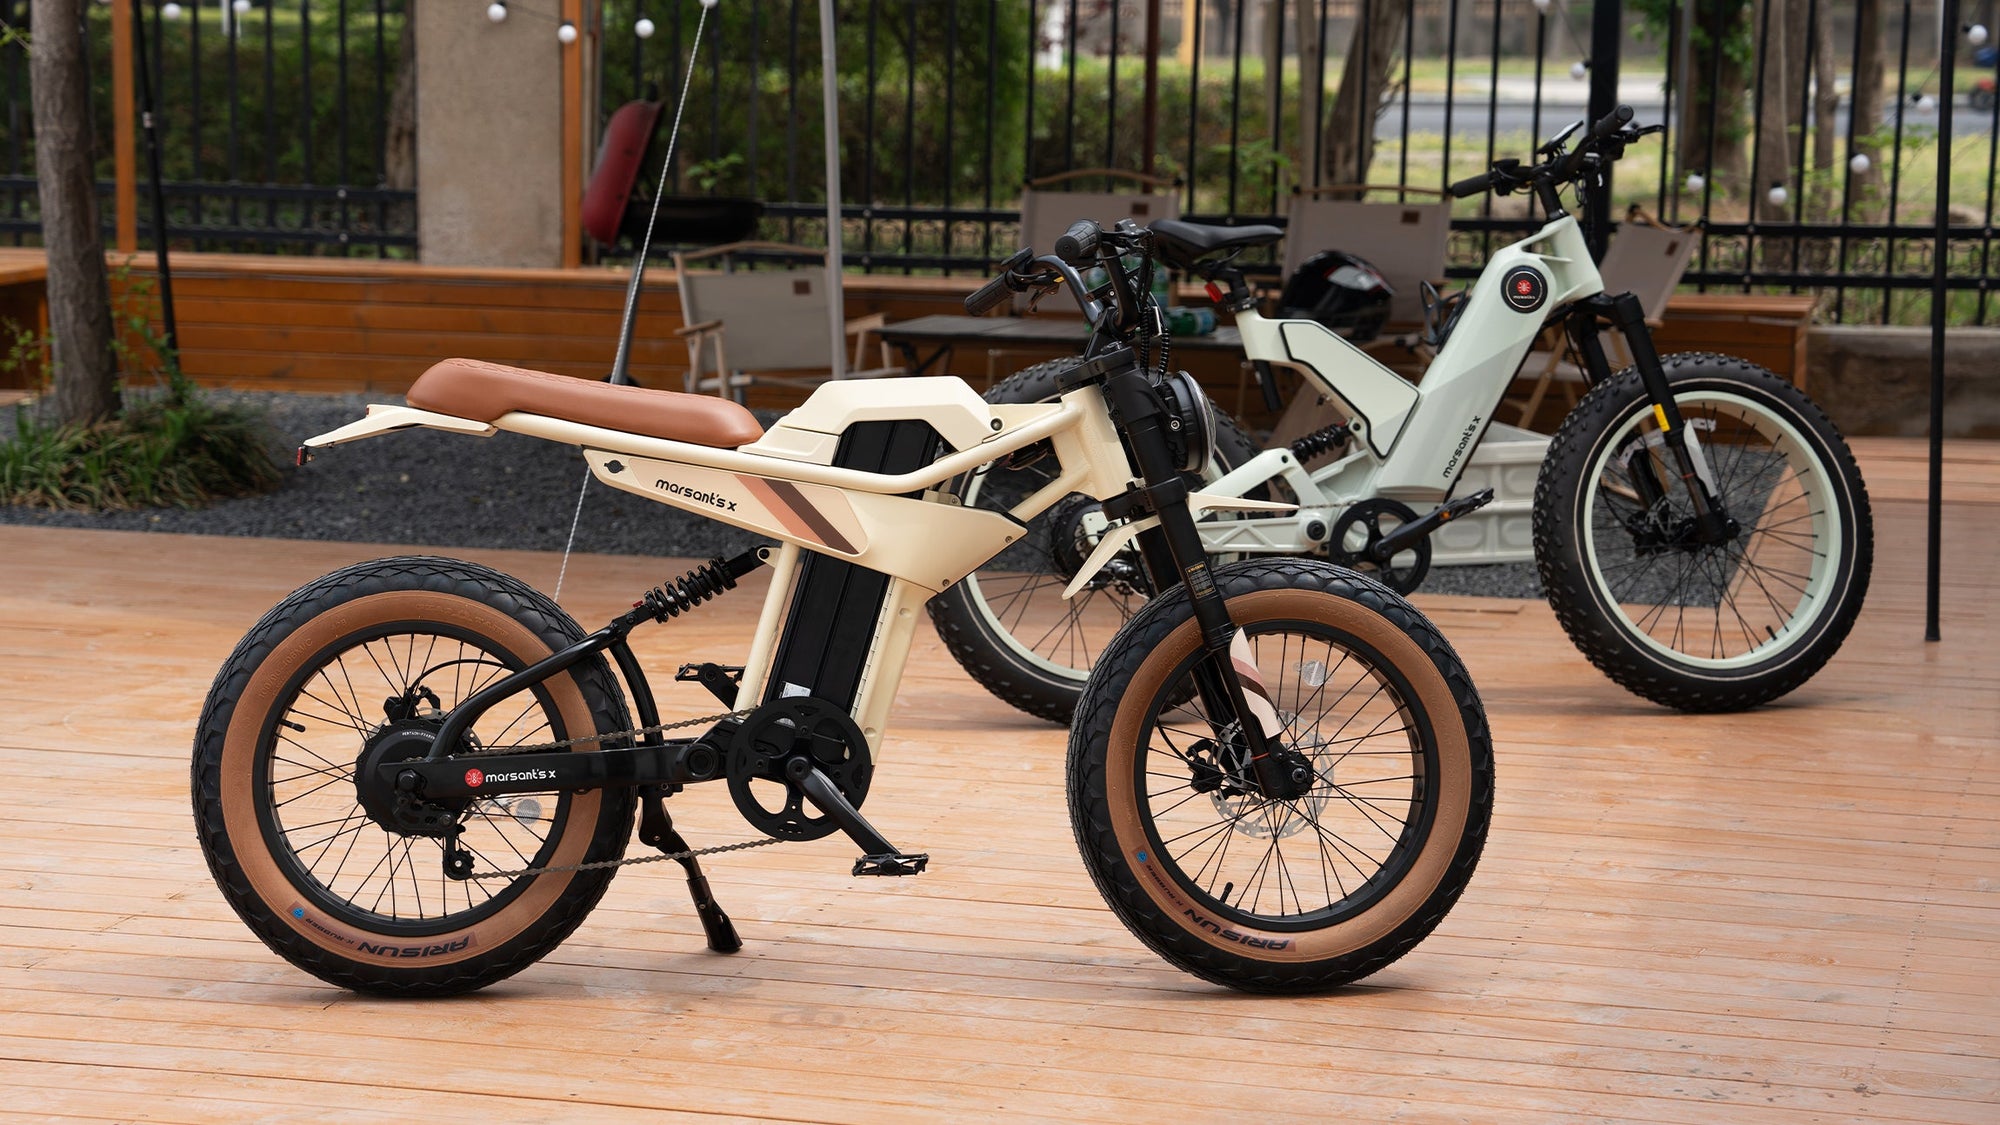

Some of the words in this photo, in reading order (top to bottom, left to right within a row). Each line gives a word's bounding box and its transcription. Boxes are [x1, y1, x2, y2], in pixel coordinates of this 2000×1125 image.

[1443, 424, 1477, 478] marsant's
[655, 479, 726, 508] marsant's
[727, 501, 738, 512] x
[485, 768, 547, 783] marsant's
[548, 770, 556, 779] x
[356, 925, 470, 958] ARISUN
[1183, 907, 1290, 951] ARISUN
